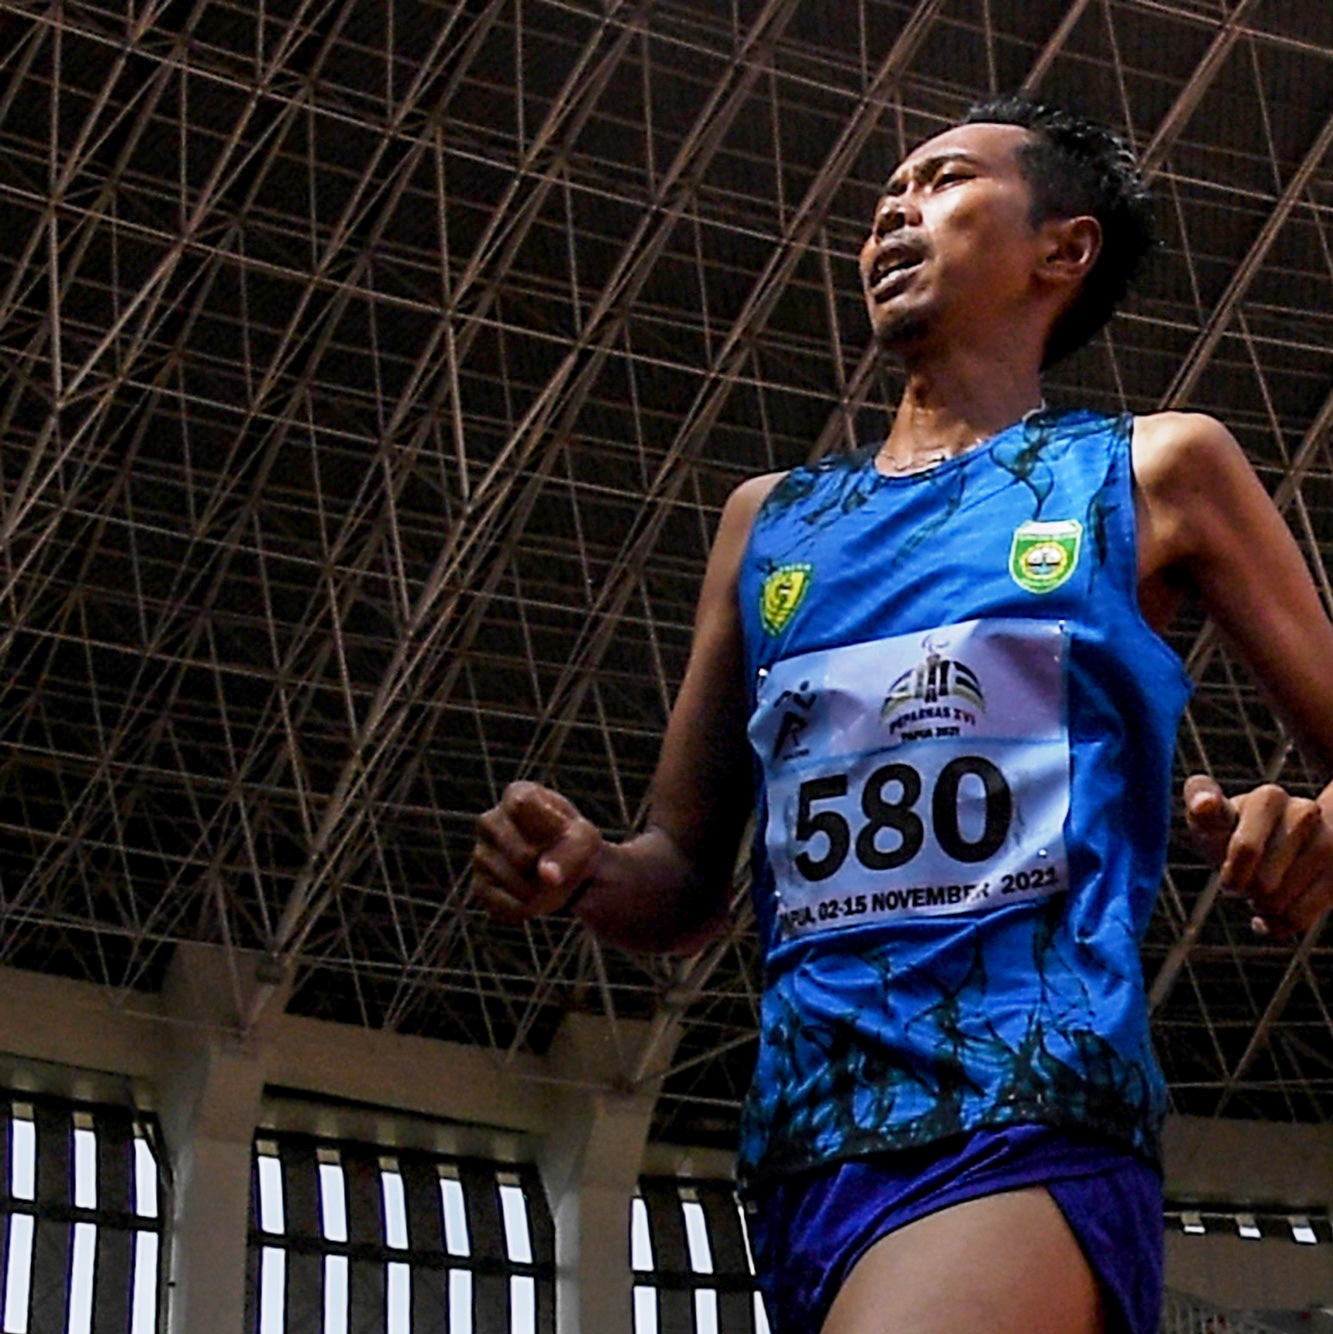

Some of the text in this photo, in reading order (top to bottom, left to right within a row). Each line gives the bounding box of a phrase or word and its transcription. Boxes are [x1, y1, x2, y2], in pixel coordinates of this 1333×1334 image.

[793, 756, 1013, 883] 580
[818, 894, 868, 921] 02-15
[871, 882, 990, 912] NOVEMBER
[1001, 866, 1059, 894] 2021
